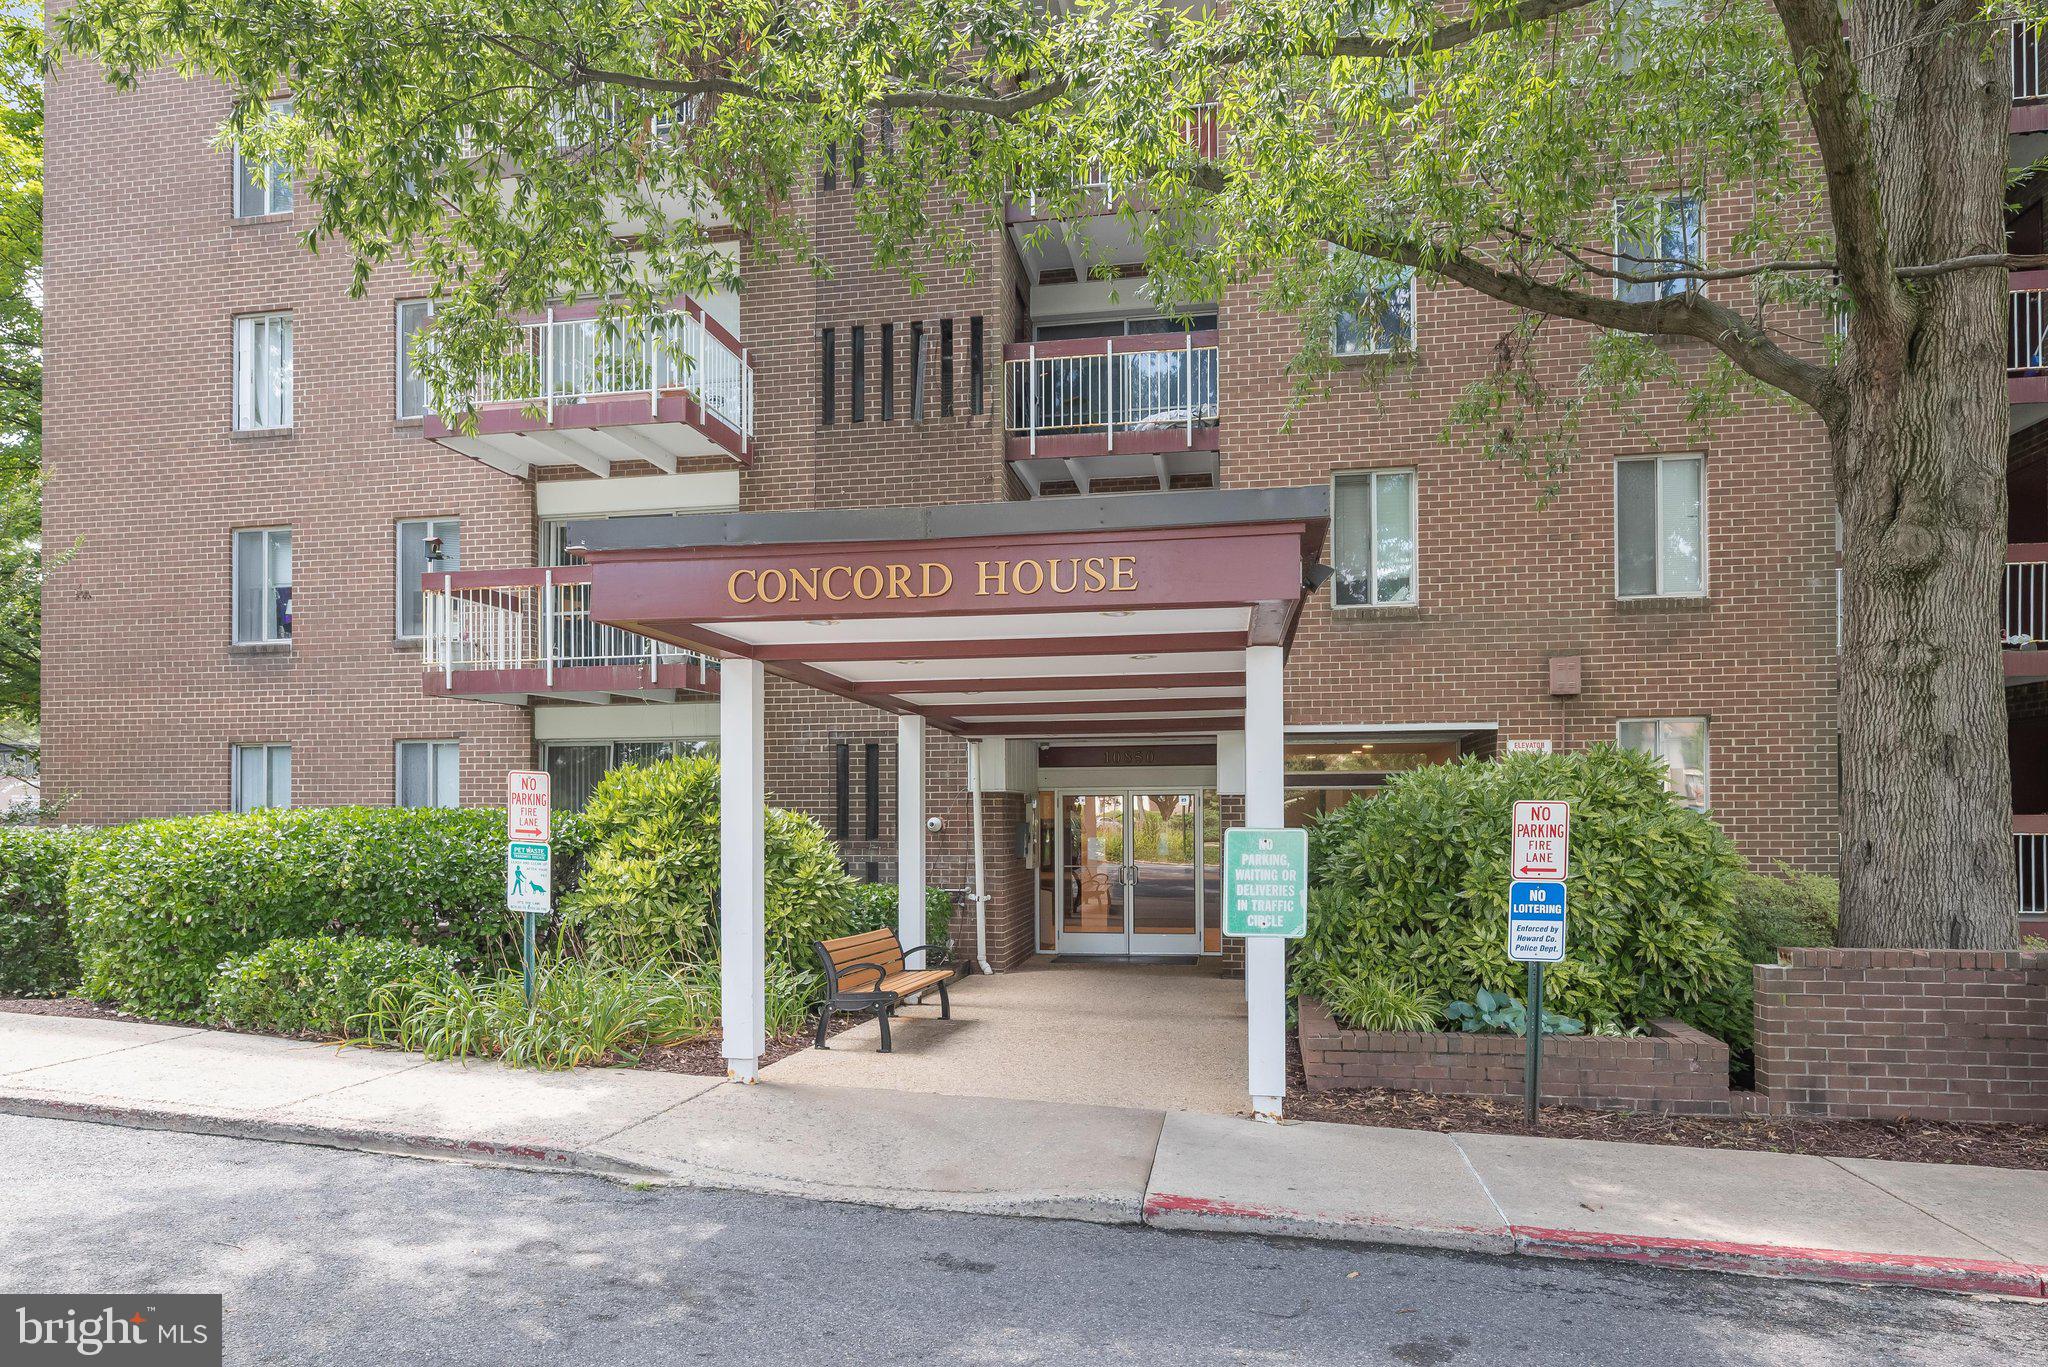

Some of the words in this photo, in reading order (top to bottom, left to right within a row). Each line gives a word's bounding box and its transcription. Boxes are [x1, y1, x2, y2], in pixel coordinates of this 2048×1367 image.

[727, 562, 954, 604] CONCORD
[974, 555, 1139, 596] HOUSE
[522, 777, 537, 790] NO
[511, 792, 547, 807] PARKING
[520, 807, 537, 816] FIRE
[1531, 806, 1551, 821] NO
[519, 818, 538, 826] LANE
[1517, 824, 1564, 838] PARKING
[527, 847, 545, 855] WASTE
[1258, 838, 1274, 851] NO
[1528, 841, 1552, 850] FIRE
[1241, 854, 1290, 868] PARKING,
[1526, 853, 1553, 863] LANE
[1235, 869, 1278, 881] WAITING
[1282, 869, 1297, 881] OR
[1236, 884, 1295, 897] DELIVERIES
[1529, 889, 1546, 902] NO
[1237, 899, 1248, 911] IN
[1251, 900, 1294, 912] TRAFFIC
[1513, 904, 1562, 914] LOITERING
[1247, 915, 1284, 928] CIRCLE
[1516, 925, 1549, 933] Enforced
[1550, 926, 1559, 934] by
[1517, 934, 1544, 942] Howard
[1545, 935, 1557, 943] Co.
[1515, 944, 1538, 952] Police
[1540, 945, 1559, 953] Dept.
